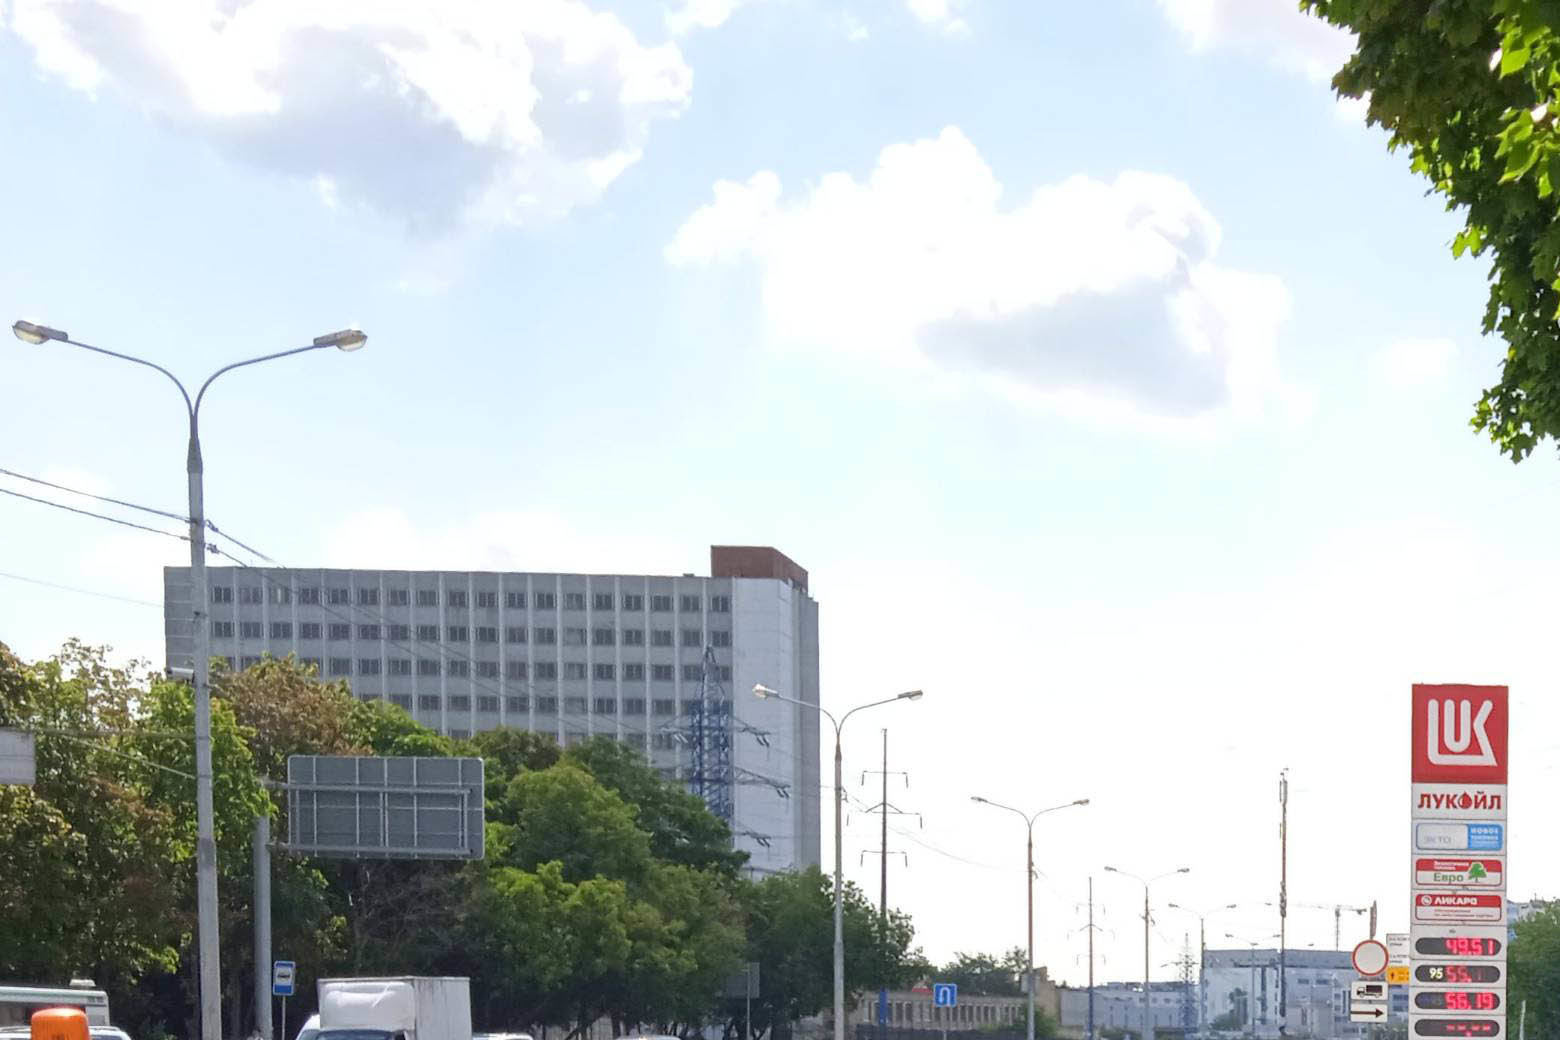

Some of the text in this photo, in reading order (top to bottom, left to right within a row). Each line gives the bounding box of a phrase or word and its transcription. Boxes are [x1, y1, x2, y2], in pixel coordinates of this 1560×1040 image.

[1417, 790, 1502, 810] ЛУКОЙЛ
[1433, 872, 1464, 885] Евро
[1429, 967, 1443, 979] 95
